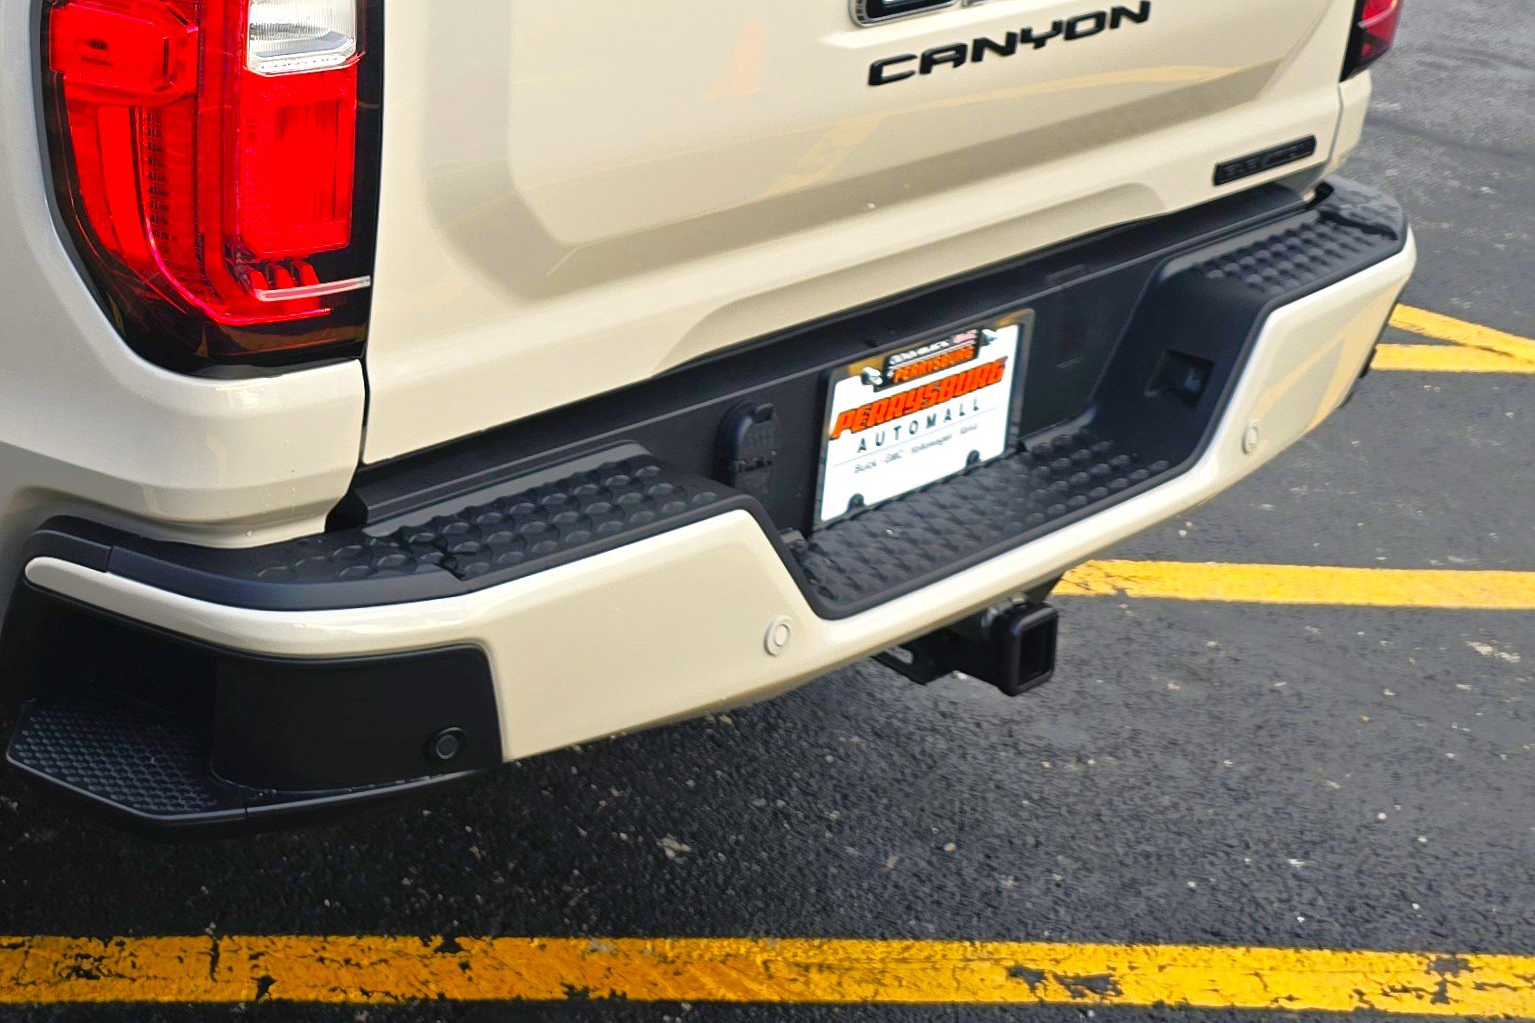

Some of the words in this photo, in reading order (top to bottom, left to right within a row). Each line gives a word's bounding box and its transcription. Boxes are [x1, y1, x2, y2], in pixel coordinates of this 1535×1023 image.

[867, 0, 1152, 87] CANYON
[828, 356, 1008, 441] PERRYSBURG
[856, 397, 980, 453] AUTOMALL
